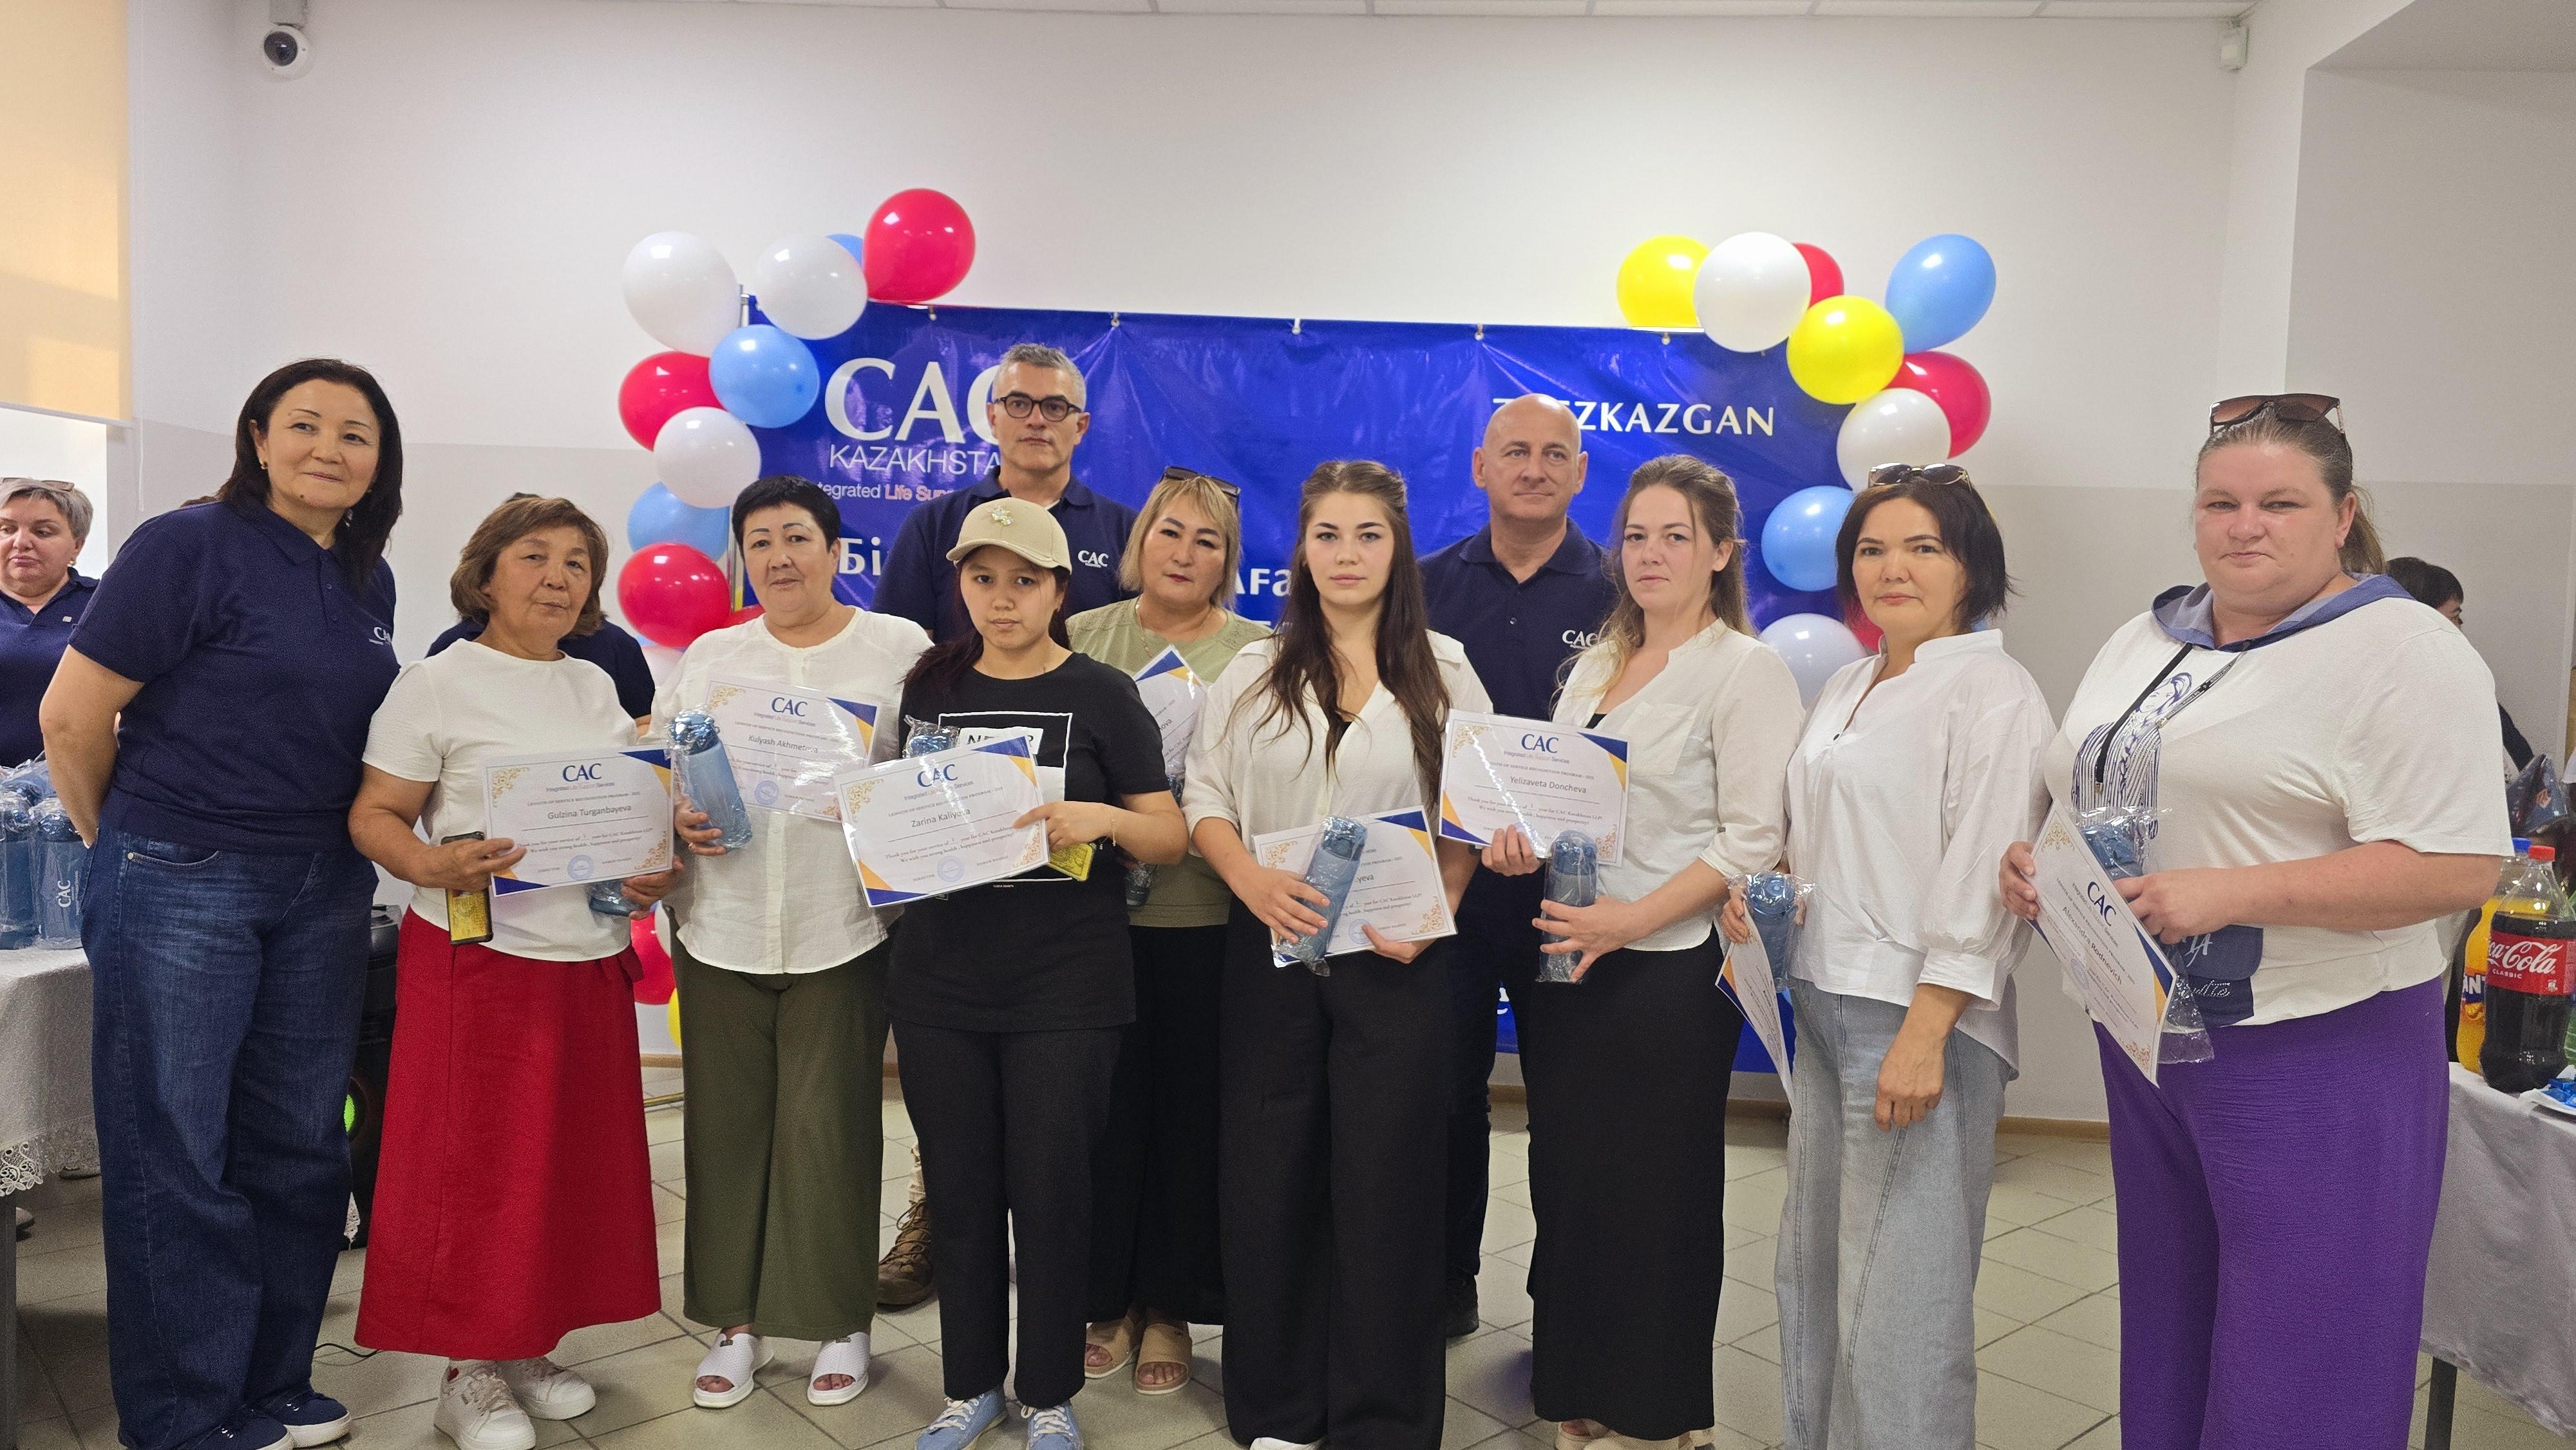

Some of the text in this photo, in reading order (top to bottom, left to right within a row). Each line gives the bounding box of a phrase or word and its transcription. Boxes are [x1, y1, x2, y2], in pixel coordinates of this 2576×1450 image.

[830, 444, 1001, 475] KAZAKHSTA
[817, 482, 881, 500] tegrated
[885, 484, 912, 500] Life
[1077, 550, 1109, 567] CAC
[374, 626, 392, 643] CA
[772, 697, 808, 717] CAC
[1159, 719, 1173, 731] ova
[748, 735, 775, 746] Kulyash
[776, 740, 818, 753] Akhmeta
[1521, 733, 1559, 754] CAC
[562, 763, 601, 782] CAC
[917, 764, 958, 787] CAC
[1510, 776, 1587, 793] Yelizaveta Doncheva
[547, 805, 632, 820] Gulzina Turganbayeva
[911, 816, 936, 828] Zarina
[1357, 874, 1374, 883] yeva
[57, 880, 71, 907] CAC
[2087, 881, 2116, 927] CAC
[2063, 907, 2122, 985] Alexandra Rodnevich
[2488, 941, 2563, 974] ca-Cola
[2492, 968, 2523, 979] CLASSIC
